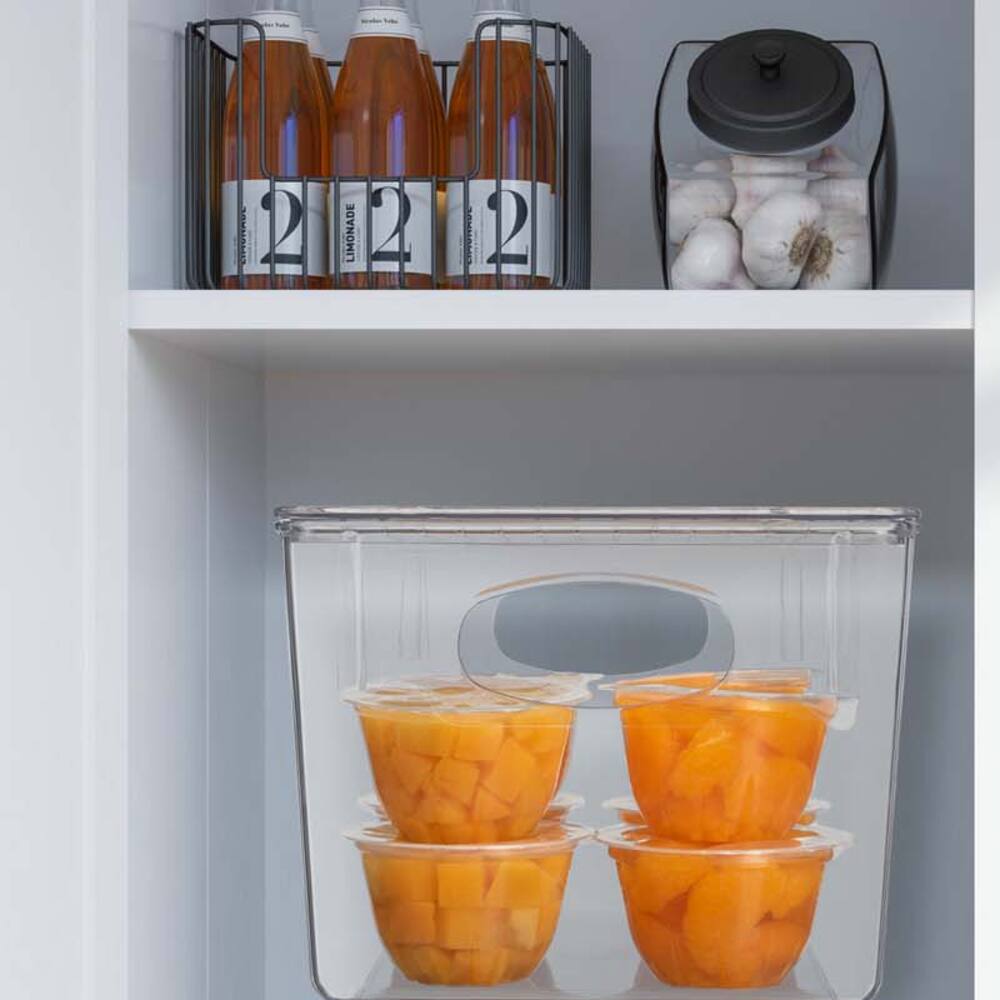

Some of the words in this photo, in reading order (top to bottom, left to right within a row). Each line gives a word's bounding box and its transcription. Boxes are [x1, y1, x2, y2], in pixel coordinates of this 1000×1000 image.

[260, 189, 305, 265] 2
[345, 203, 355, 263] LIMONADE
[369, 185, 412, 263] 2
[486, 189, 528, 266] 2
